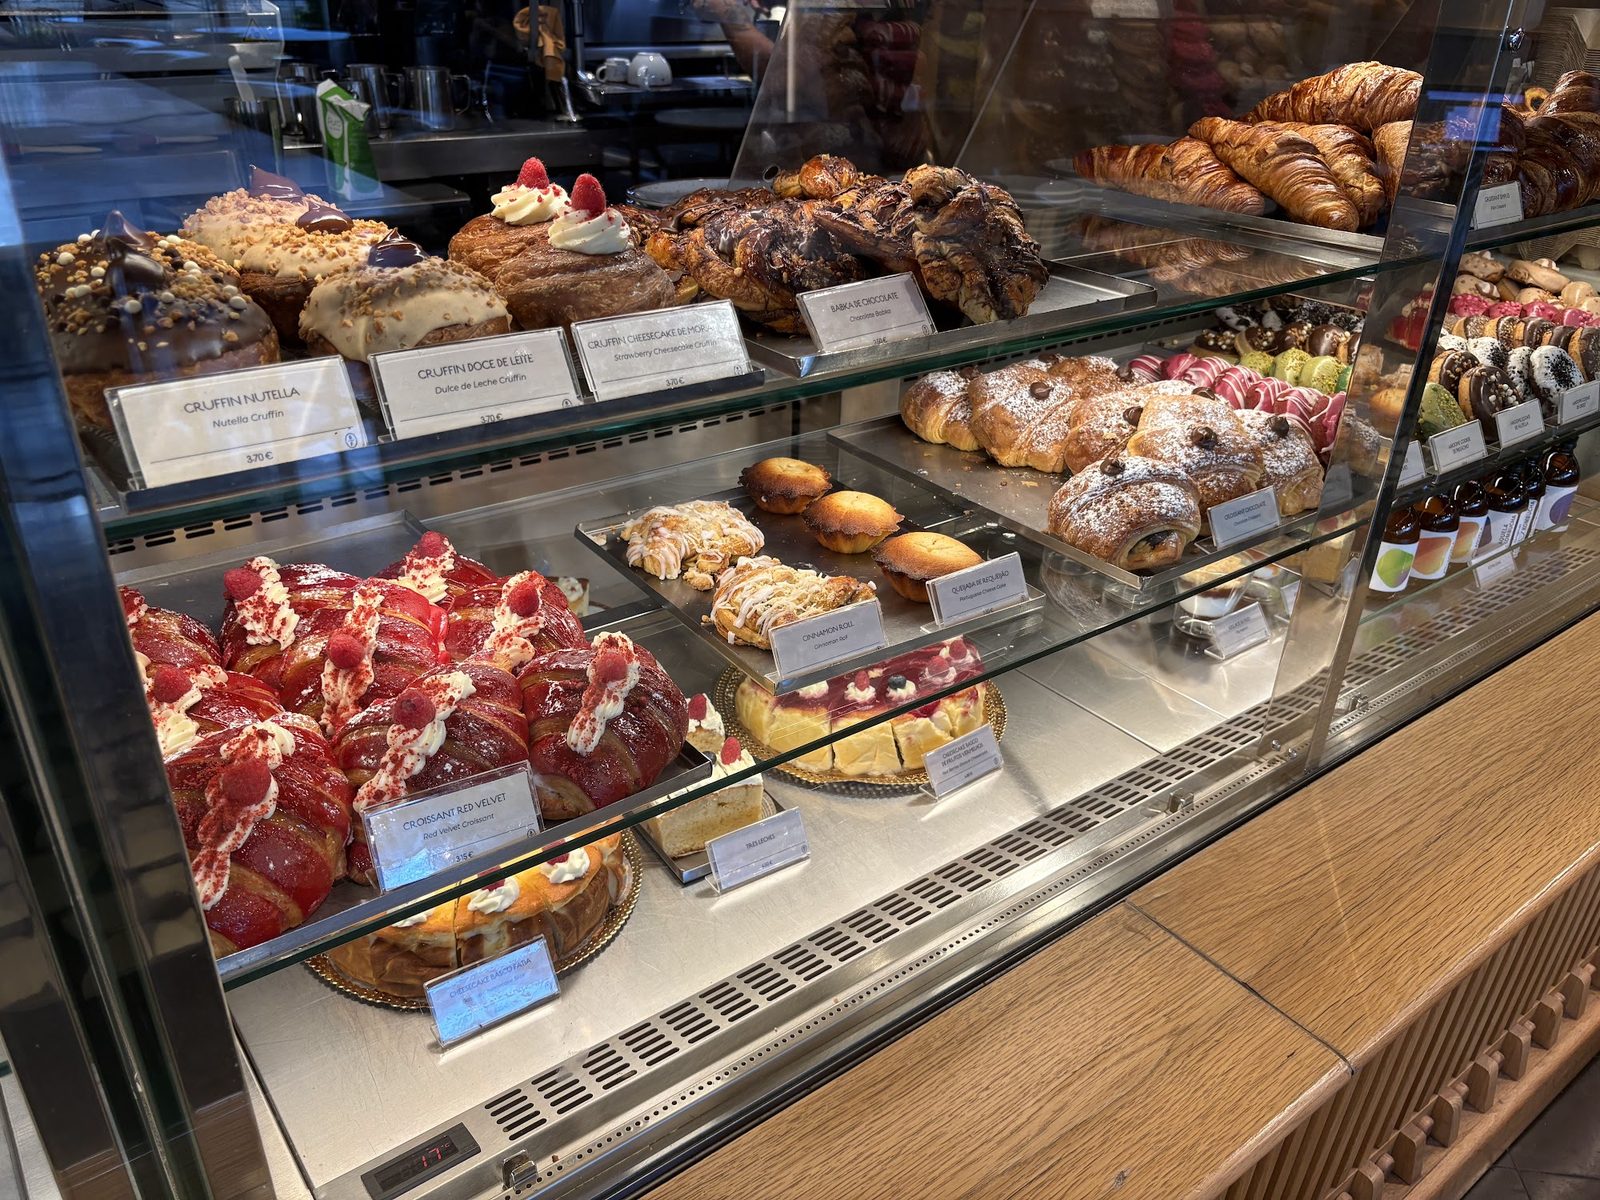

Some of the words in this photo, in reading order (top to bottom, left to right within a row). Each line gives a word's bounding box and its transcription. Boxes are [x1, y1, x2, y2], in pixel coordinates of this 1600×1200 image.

[830, 302, 854, 312] BABKA
[854, 300, 862, 308] DE
[862, 292, 898, 307] CHOCOLATE
[850, 312, 876, 322] Chocolate
[876, 308, 891, 318] Babka
[588, 336, 626, 350] CRUFFIN
[628, 329, 676, 344] CHEESECAKE
[677, 327, 686, 336] DE
[614, 350, 652, 362] Strawberry
[654, 344, 694, 356] Cheesecake
[694, 340, 718, 348] Cruffin
[418, 364, 466, 380] CRUFFIN
[468, 360, 496, 372] DOCE
[497, 358, 508, 368] DE
[510, 354, 534, 365] LEITE
[435, 384, 460, 394] Dulce
[460, 382, 472, 390] de
[474, 378, 498, 388] Leche
[499, 374, 526, 384] Cruffin
[183, 395, 241, 414] CRUFFIN
[246, 387, 300, 404] NUTELLA
[212, 415, 248, 428] Nutella
[250, 409, 284, 422] Cruffin
[952, 582, 976, 594] QUEIJADA
[802, 626, 839, 642] CINNAMON
[839, 620, 855, 630] ROLL
[402, 808, 456, 831] CROISSANT
[457, 804, 474, 814] RED
[476, 792, 506, 807] VELVET
[424, 832, 438, 840] Red
[439, 823, 462, 836] Velvet
[462, 814, 494, 828] Croissant
[758, 834, 776, 845] LECHES
[450, 976, 490, 998] CHEESECAKE
[490, 966, 512, 980] BASCO
[513, 958, 532, 971] FATIA
